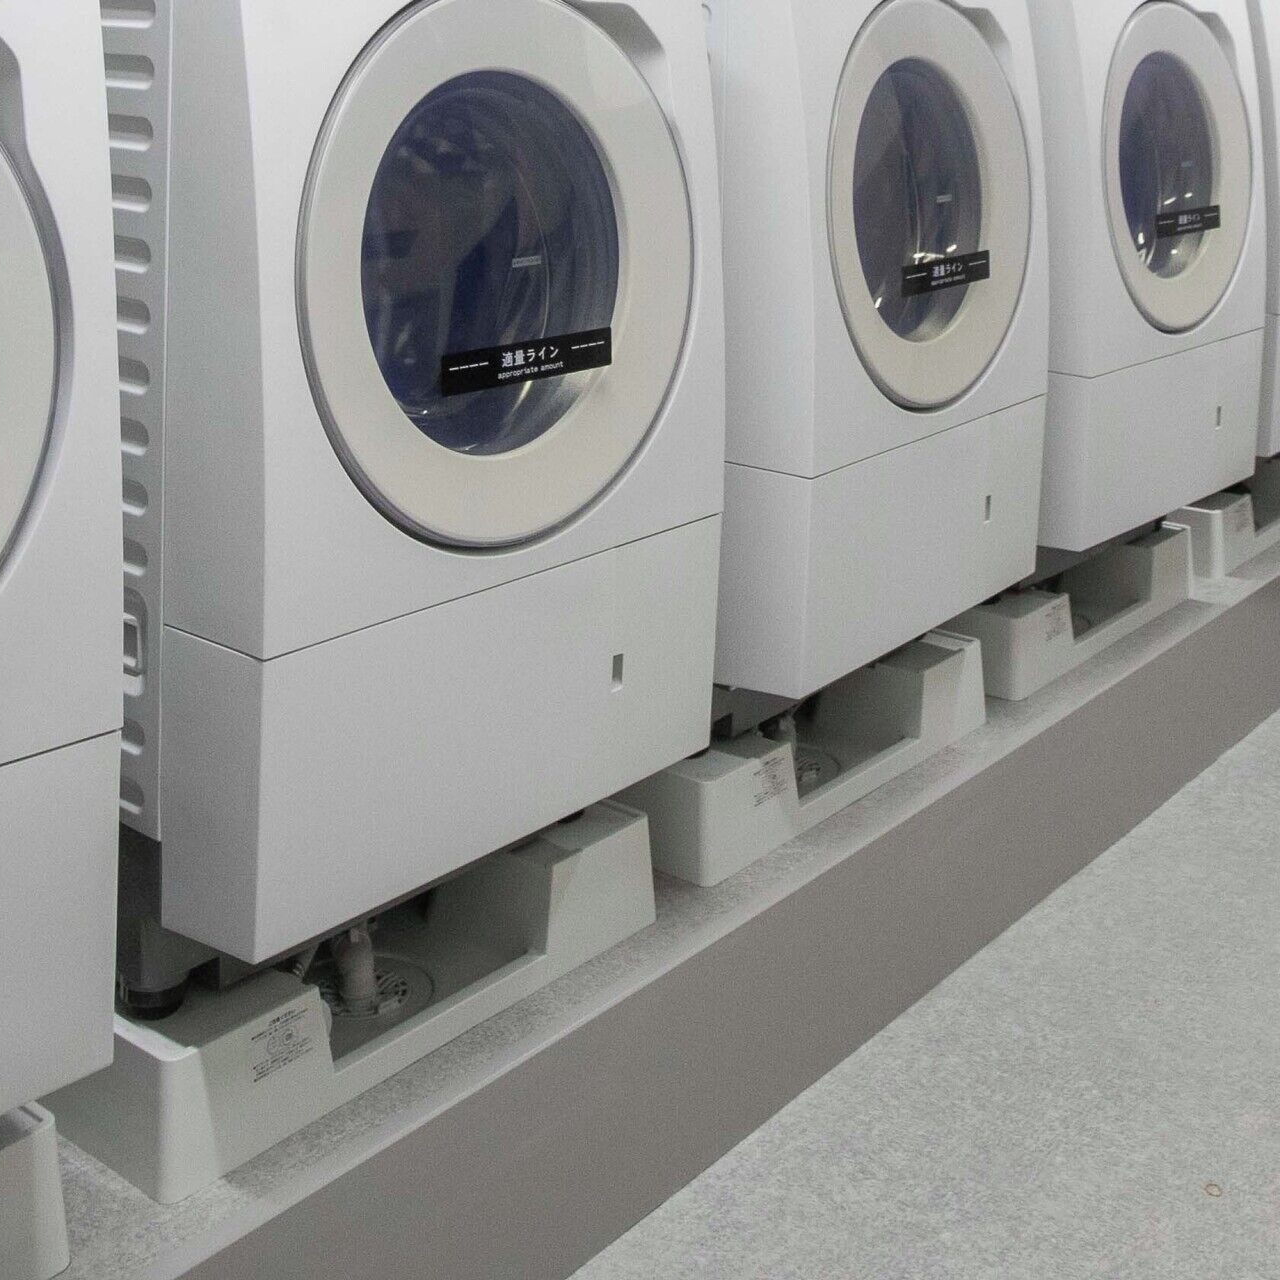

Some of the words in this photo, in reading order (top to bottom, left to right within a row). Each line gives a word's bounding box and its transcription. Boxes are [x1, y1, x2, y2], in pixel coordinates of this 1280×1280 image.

[501, 345, 560, 368] 適量ライン
[497, 366, 539, 380] appropriate
[540, 361, 564, 372] amount
